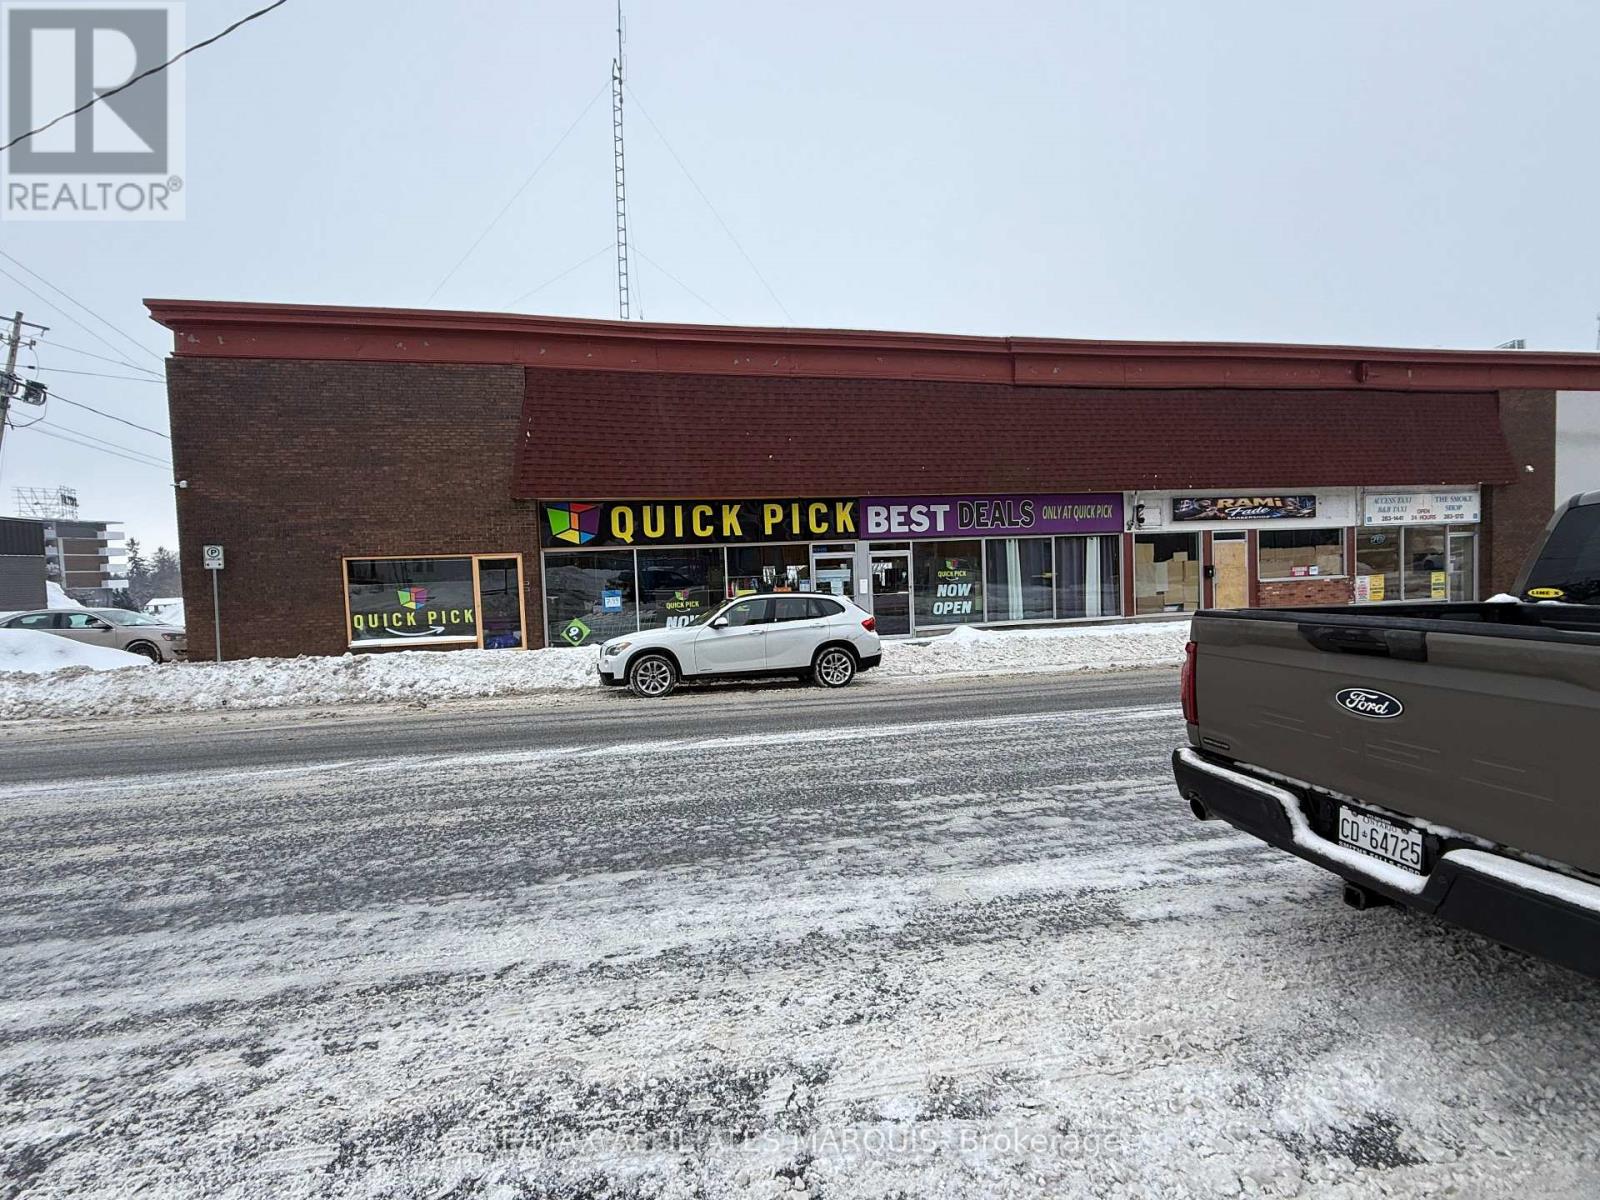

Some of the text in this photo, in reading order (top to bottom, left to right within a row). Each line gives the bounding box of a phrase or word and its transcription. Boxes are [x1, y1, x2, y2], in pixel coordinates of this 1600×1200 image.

[1217, 497, 1283, 508] RAMi
[611, 502, 856, 543] QUICK PICK
[867, 500, 1113, 533] BEST DEALS ONLY AT QUICK PICK
[937, 570, 953, 578] QUICK
[937, 583, 971, 597] NOW
[666, 601, 684, 609] QUICK
[933, 601, 971, 614] OPEN
[354, 609, 474, 629] QUICK PICK
[1345, 692, 1390, 715] Ford
[1370, 828, 1420, 865] 64725
